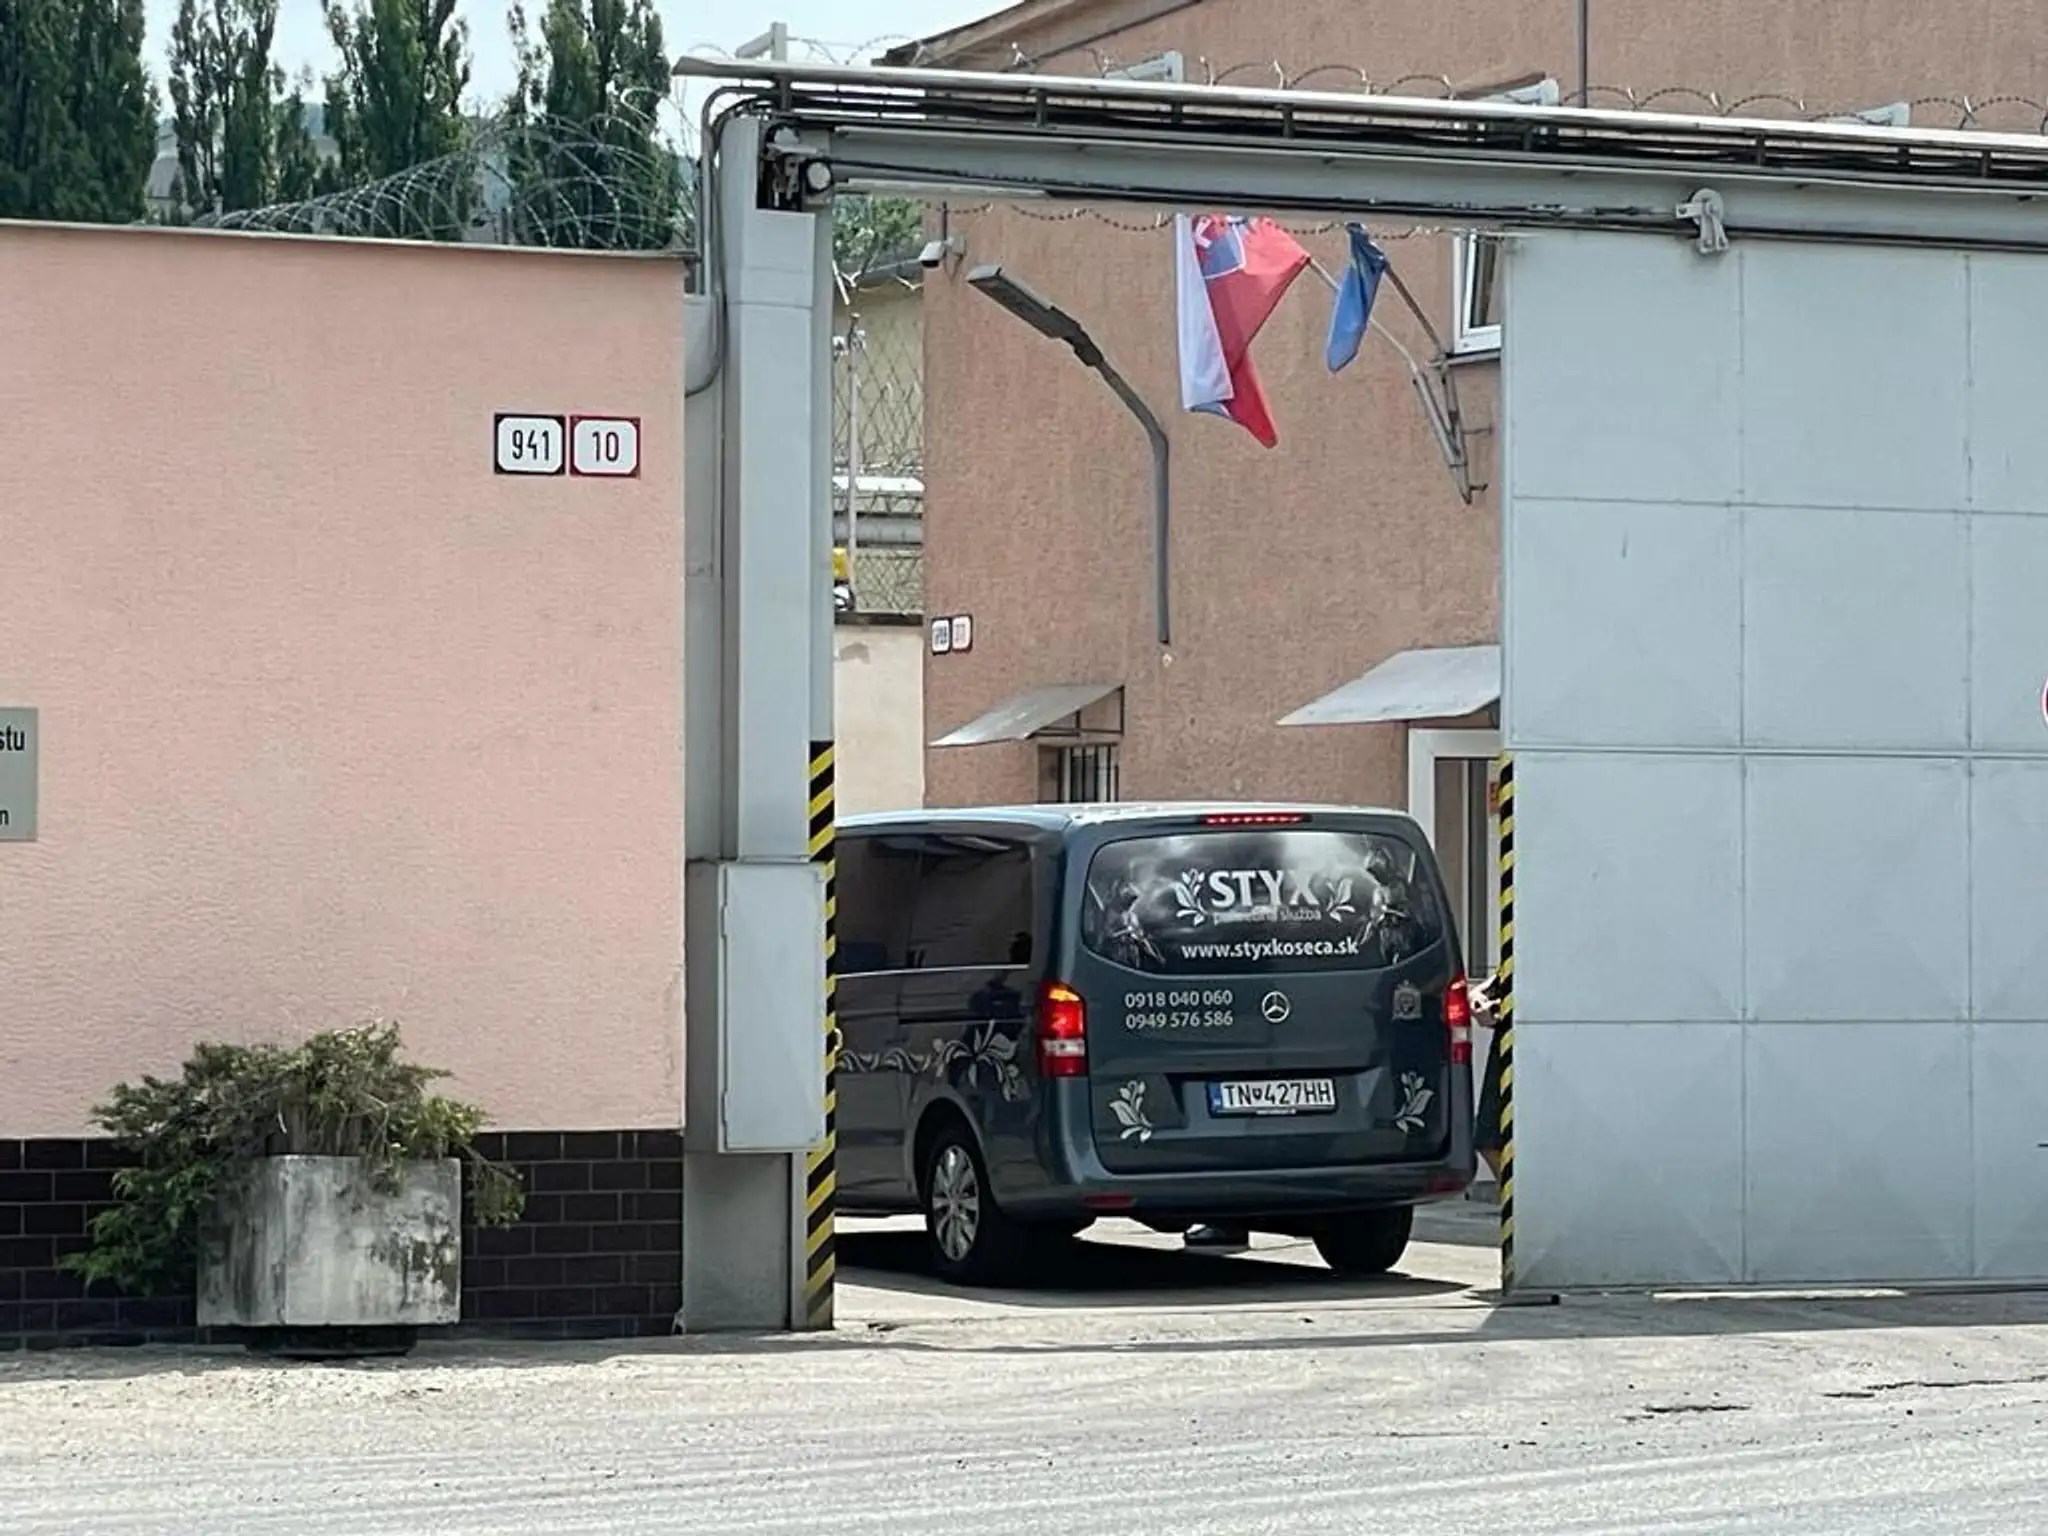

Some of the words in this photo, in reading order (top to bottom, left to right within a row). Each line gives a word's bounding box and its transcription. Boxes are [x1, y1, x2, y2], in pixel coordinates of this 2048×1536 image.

[512, 429, 550, 461] 941
[592, 431, 620, 462] 10
[1208, 869, 1320, 907] STYX
[1181, 937, 1359, 961] www.styxkoseca.sk
[1124, 991, 1166, 1008] 0918
[1169, 991, 1200, 1007] 040
[1202, 989, 1233, 1006] 060
[1125, 1012, 1167, 1029] 0949
[1170, 1011, 1200, 1028] 576
[1203, 1010, 1234, 1026] 586
